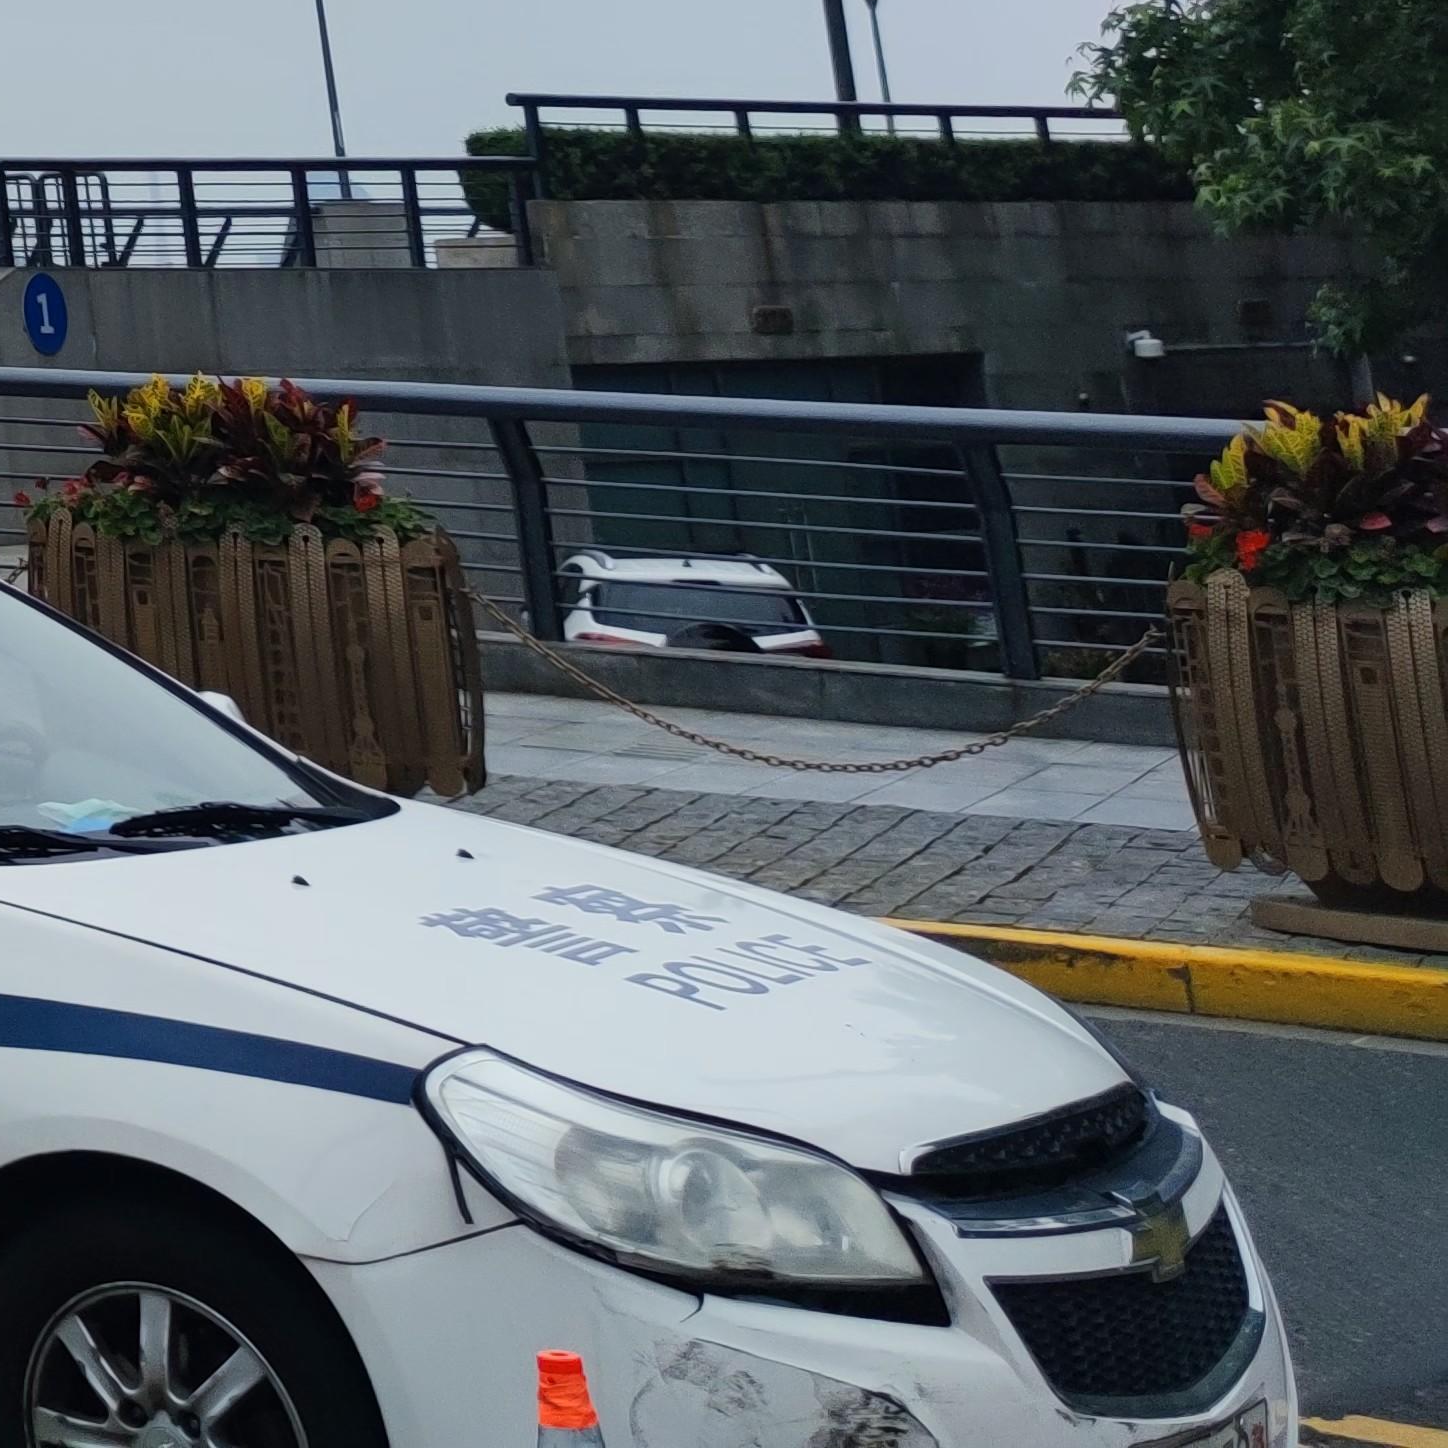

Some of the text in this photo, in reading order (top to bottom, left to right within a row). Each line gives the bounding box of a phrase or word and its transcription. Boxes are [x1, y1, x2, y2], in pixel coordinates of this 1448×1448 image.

[36, 292, 55, 334] 1
[418, 883, 733, 966] 警察
[623, 933, 874, 1012] POLICE
